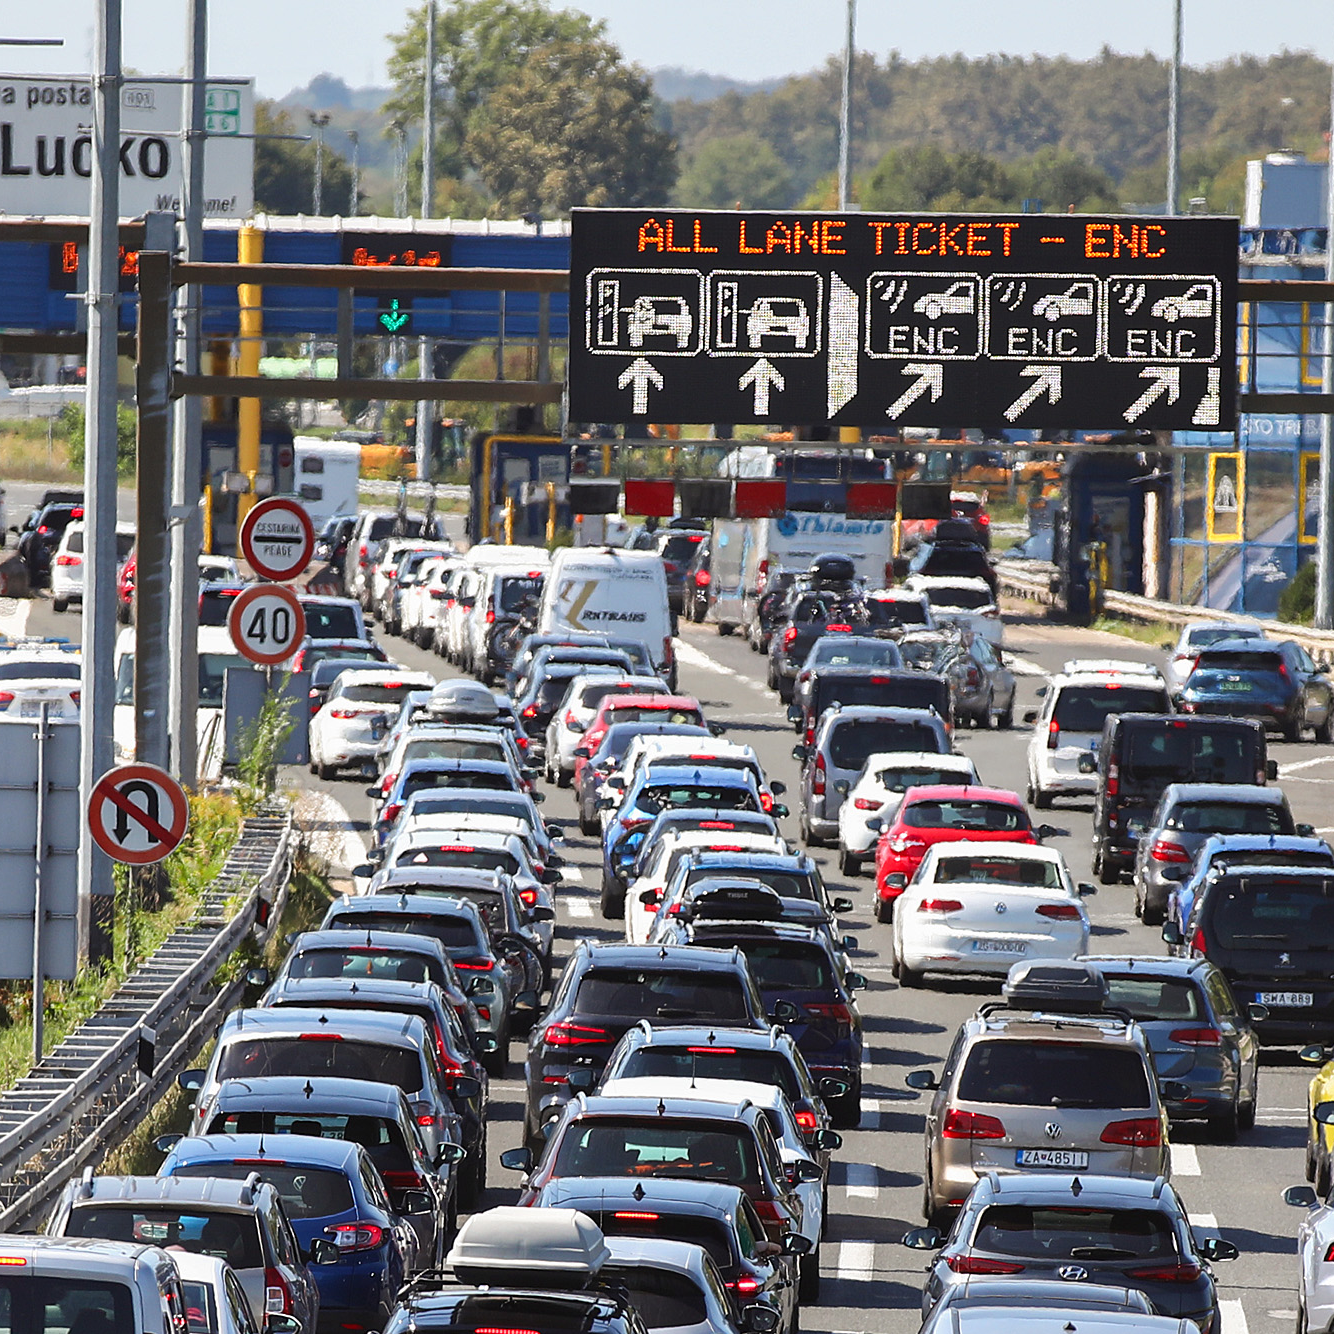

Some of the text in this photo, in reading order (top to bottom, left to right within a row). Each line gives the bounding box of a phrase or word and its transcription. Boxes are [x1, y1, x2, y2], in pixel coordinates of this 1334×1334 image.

[27, 83, 92, 110] posta
[637, 219, 719, 255] ALL
[739, 220, 847, 256] LANE
[867, 221, 1020, 258] TICKET
[1083, 223, 1167, 259] ENC
[887, 326, 960, 356] ENC
[1007, 328, 1079, 357] ENC
[1126, 329, 1197, 358] ENC
[257, 522, 301, 533] CESTARINA
[247, 606, 290, 644] 40
[1024, 1150, 1040, 1163] ZA
